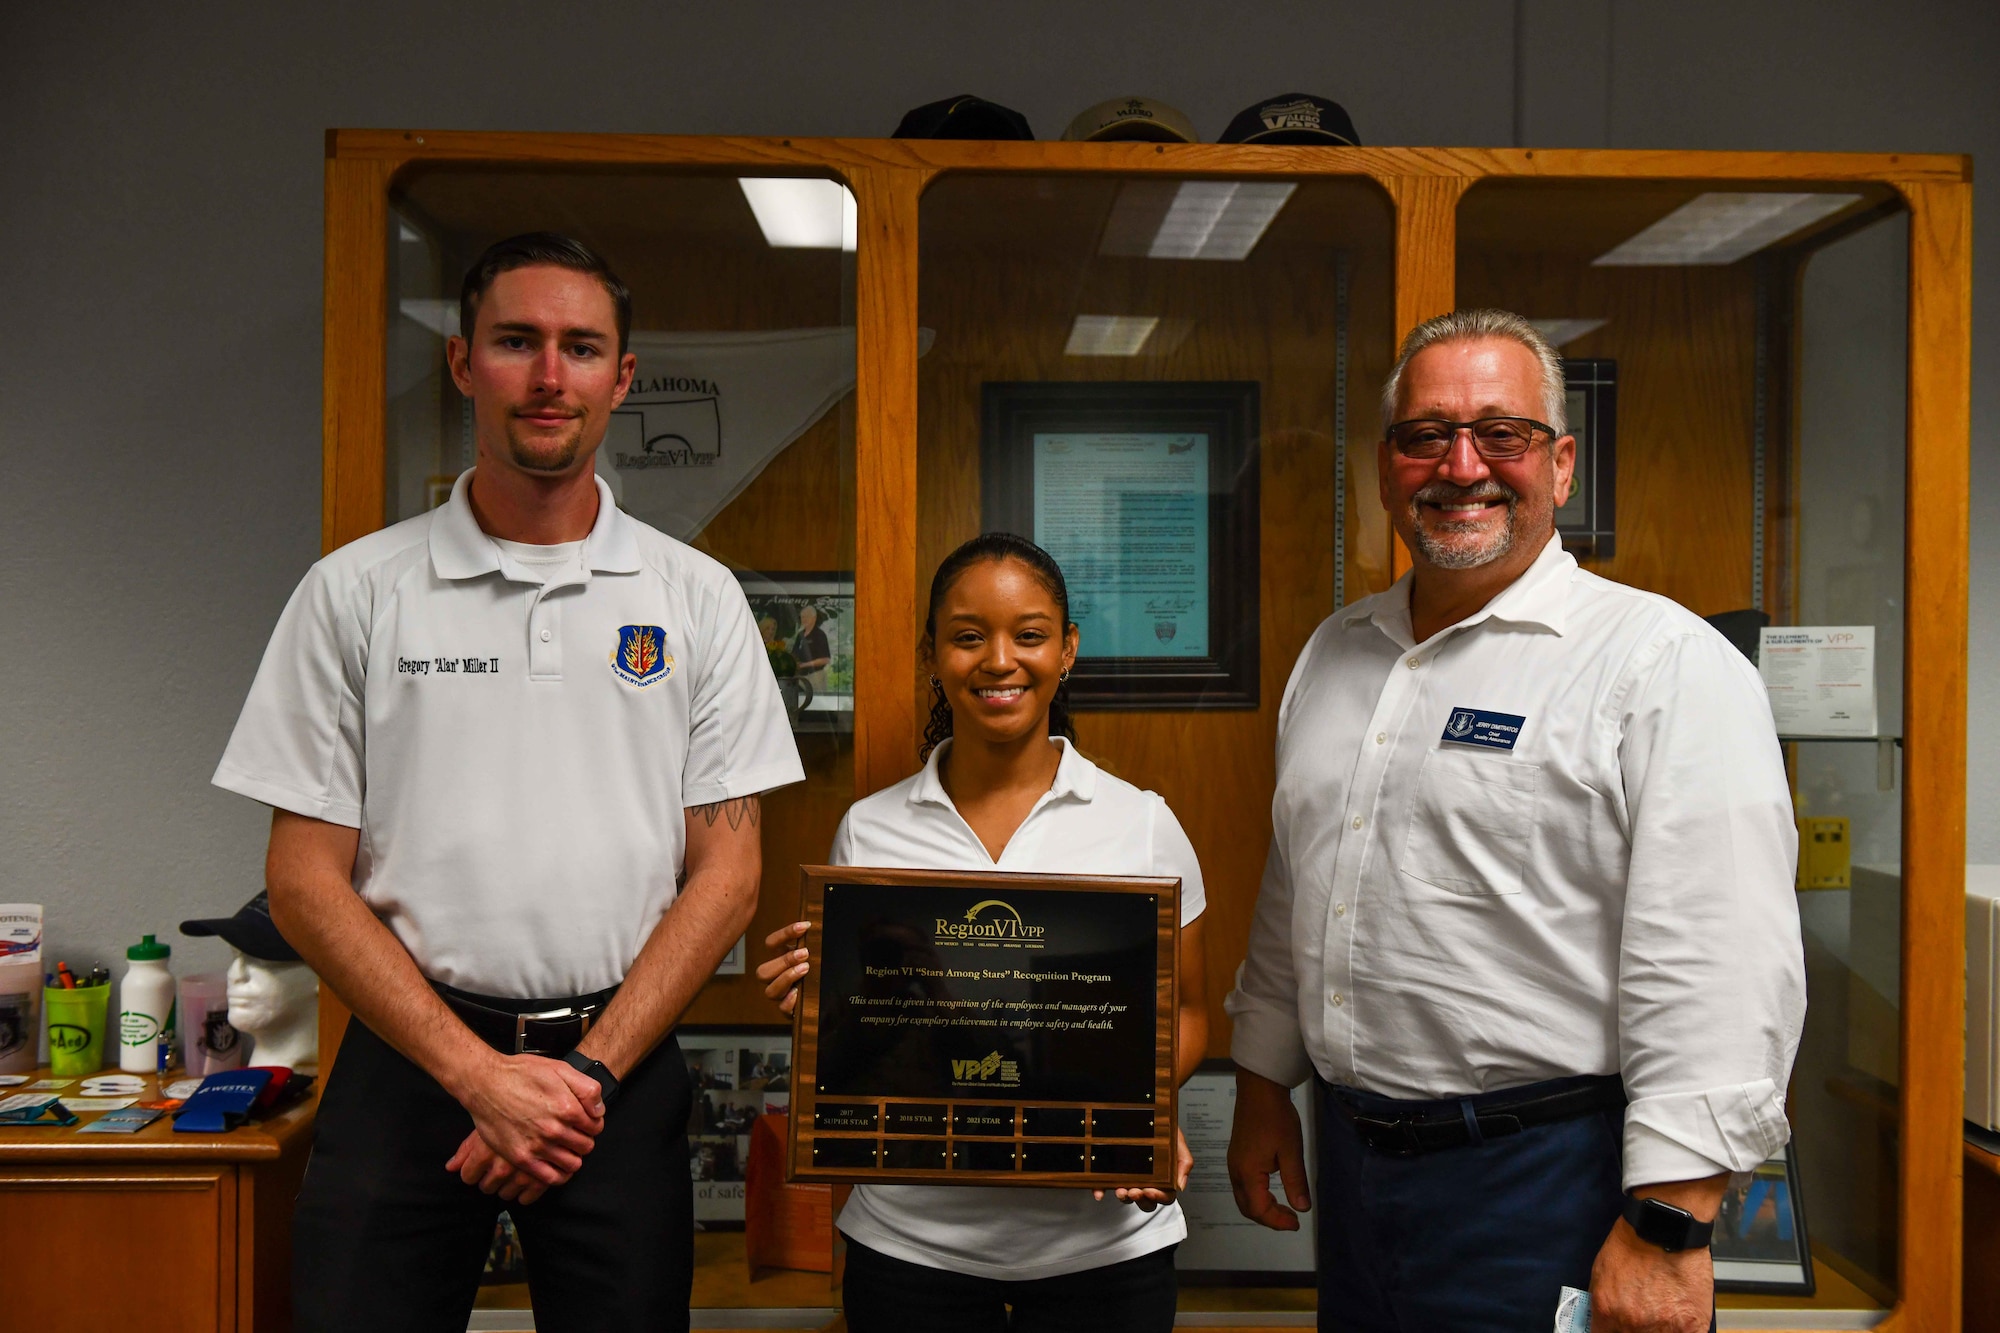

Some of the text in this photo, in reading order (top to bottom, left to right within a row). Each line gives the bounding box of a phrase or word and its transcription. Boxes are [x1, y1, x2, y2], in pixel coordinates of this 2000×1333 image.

[630, 378, 720, 395] LAHOMA
[1827, 633, 1854, 644] VPP
[398, 658, 499, 675] Gregory "Alan" Miller II
[866, 966, 898, 977] Region
[902, 967, 912, 975] VI
[946, 969, 980, 980] Among
[1013, 970, 1068, 982] Recognition
[1072, 972, 1111, 983] Program
[849, 996, 866, 1004] This
[868, 997, 894, 1005] award
[903, 998, 924, 1008] given
[927, 998, 934, 1006] in
[937, 999, 979, 1009] recognition
[981, 999, 991, 1010] of
[992, 999, 1003, 1008] the
[1005, 1000, 1043, 1012] employees
[1045, 1002, 1060, 1010] and
[1062, 1004, 1097, 1013] managers
[1099, 1002, 1109, 1014] of
[1109, 1004, 1127, 1014] your
[861, 1015, 1113, 1030] company for exemplary achievement in employee safety and health.
[951, 1058, 999, 1081] VPP
[914, 1115, 933, 1123] STAR
[699, 1185, 745, 1198] of safe
